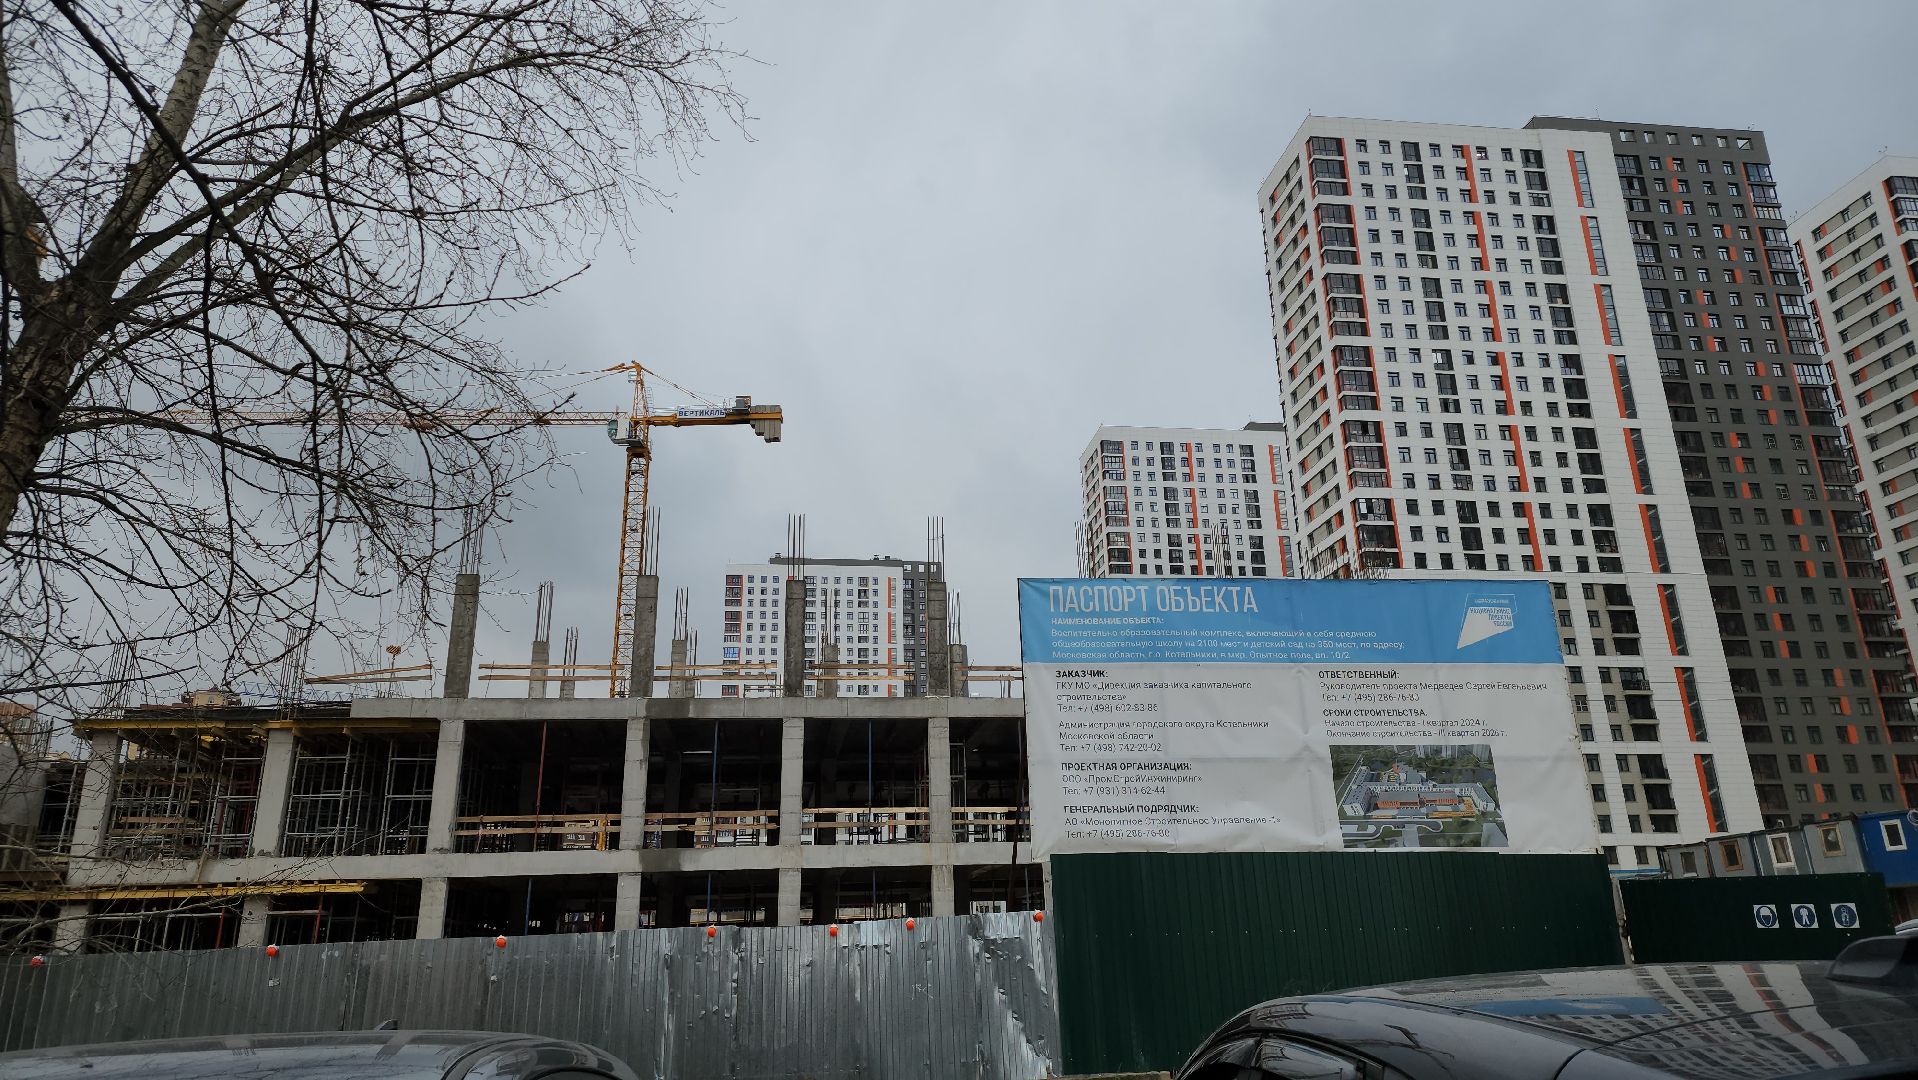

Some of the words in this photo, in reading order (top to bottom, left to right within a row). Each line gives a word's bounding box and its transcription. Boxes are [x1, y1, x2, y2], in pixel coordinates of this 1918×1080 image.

[678, 409, 726, 417] ВЕРТИКАЛЬ
[1049, 585, 1149, 612] ПАСПОРТ
[1156, 586, 1259, 613] ОБЪЕКТА
[1052, 617, 1121, 625] НАИМЕНОВАНИЕ
[1122, 616, 1165, 625] ОБЪЕКТА:
[1200, 630, 1244, 638] комплекс,
[1246, 629, 1305, 638] включающий
[1313, 630, 1334, 638] себя
[1335, 631, 1377, 640] среднюю
[1051, 639, 1154, 648] общеобразовательную
[1155, 640, 1183, 649] школу
[1197, 639, 1218, 648] 2100
[1250, 640, 1286, 649] детский
[1052, 650, 1107, 659] Московская
[1249, 650, 1289, 659] Опытное
[1290, 652, 1314, 660] поле,
[1055, 670, 1109, 678] ЗАКАЗЧИК:
[1318, 669, 1400, 679] ОТВЕТСТВЕННЫЙ:
[1055, 682, 1073, 690] ГКУ
[1092, 682, 1142, 691] «Дирекция
[1143, 682, 1189, 690] заказчика
[1320, 682, 1380, 691] Руководитель
[1382, 683, 1418, 692] проекта
[1420, 682, 1464, 691] Медведев
[1465, 681, 1496, 691] Сергей
[1497, 682, 1548, 691] Евгеньевич
[1056, 693, 1127, 702] строительства»
[1354, 692, 1376, 704] (495)
[1057, 704, 1076, 712] Тел:
[1090, 703, 1113, 714] (498)
[1323, 708, 1352, 717] СРОКИ
[1058, 720, 1131, 730] Администрация
[1133, 720, 1183, 729] городского
[1185, 721, 1215, 730] округа
[1216, 719, 1269, 728] Котельники
[1324, 719, 1355, 727] Начало
[1356, 719, 1416, 728] строительства
[1426, 719, 1459, 728] квартал
[1460, 718, 1481, 727] 2024
[1059, 731, 1115, 740] Московской
[1117, 731, 1154, 740] области
[1326, 729, 1371, 738] Окончание
[1372, 731, 1432, 739] строительства
[1447, 730, 1480, 739] квартал
[1059, 743, 1078, 752] Тел:
[1093, 742, 1116, 754] (498)
[1061, 762, 1118, 771] ПРОЕКТНАЯ
[1119, 762, 1192, 772] ОРГАНИЗАЦИЯ:
[1062, 774, 1081, 783] ООО
[1083, 774, 1203, 785] «ПромСтройИнжиниринг»
[1063, 786, 1081, 795] Тел:
[1096, 785, 1120, 797] (931)
[1064, 803, 1135, 814] ГЕНЕРАЛЬНЫЙ
[1136, 803, 1200, 814] ПОДРЯДЧИК:
[1080, 817, 1143, 826] «Монолитное
[1144, 816, 1210, 826] Строительное
[1211, 815, 1267, 826] Управление
[1065, 829, 1085, 839] Тел:
[1100, 829, 1124, 840] (495)
